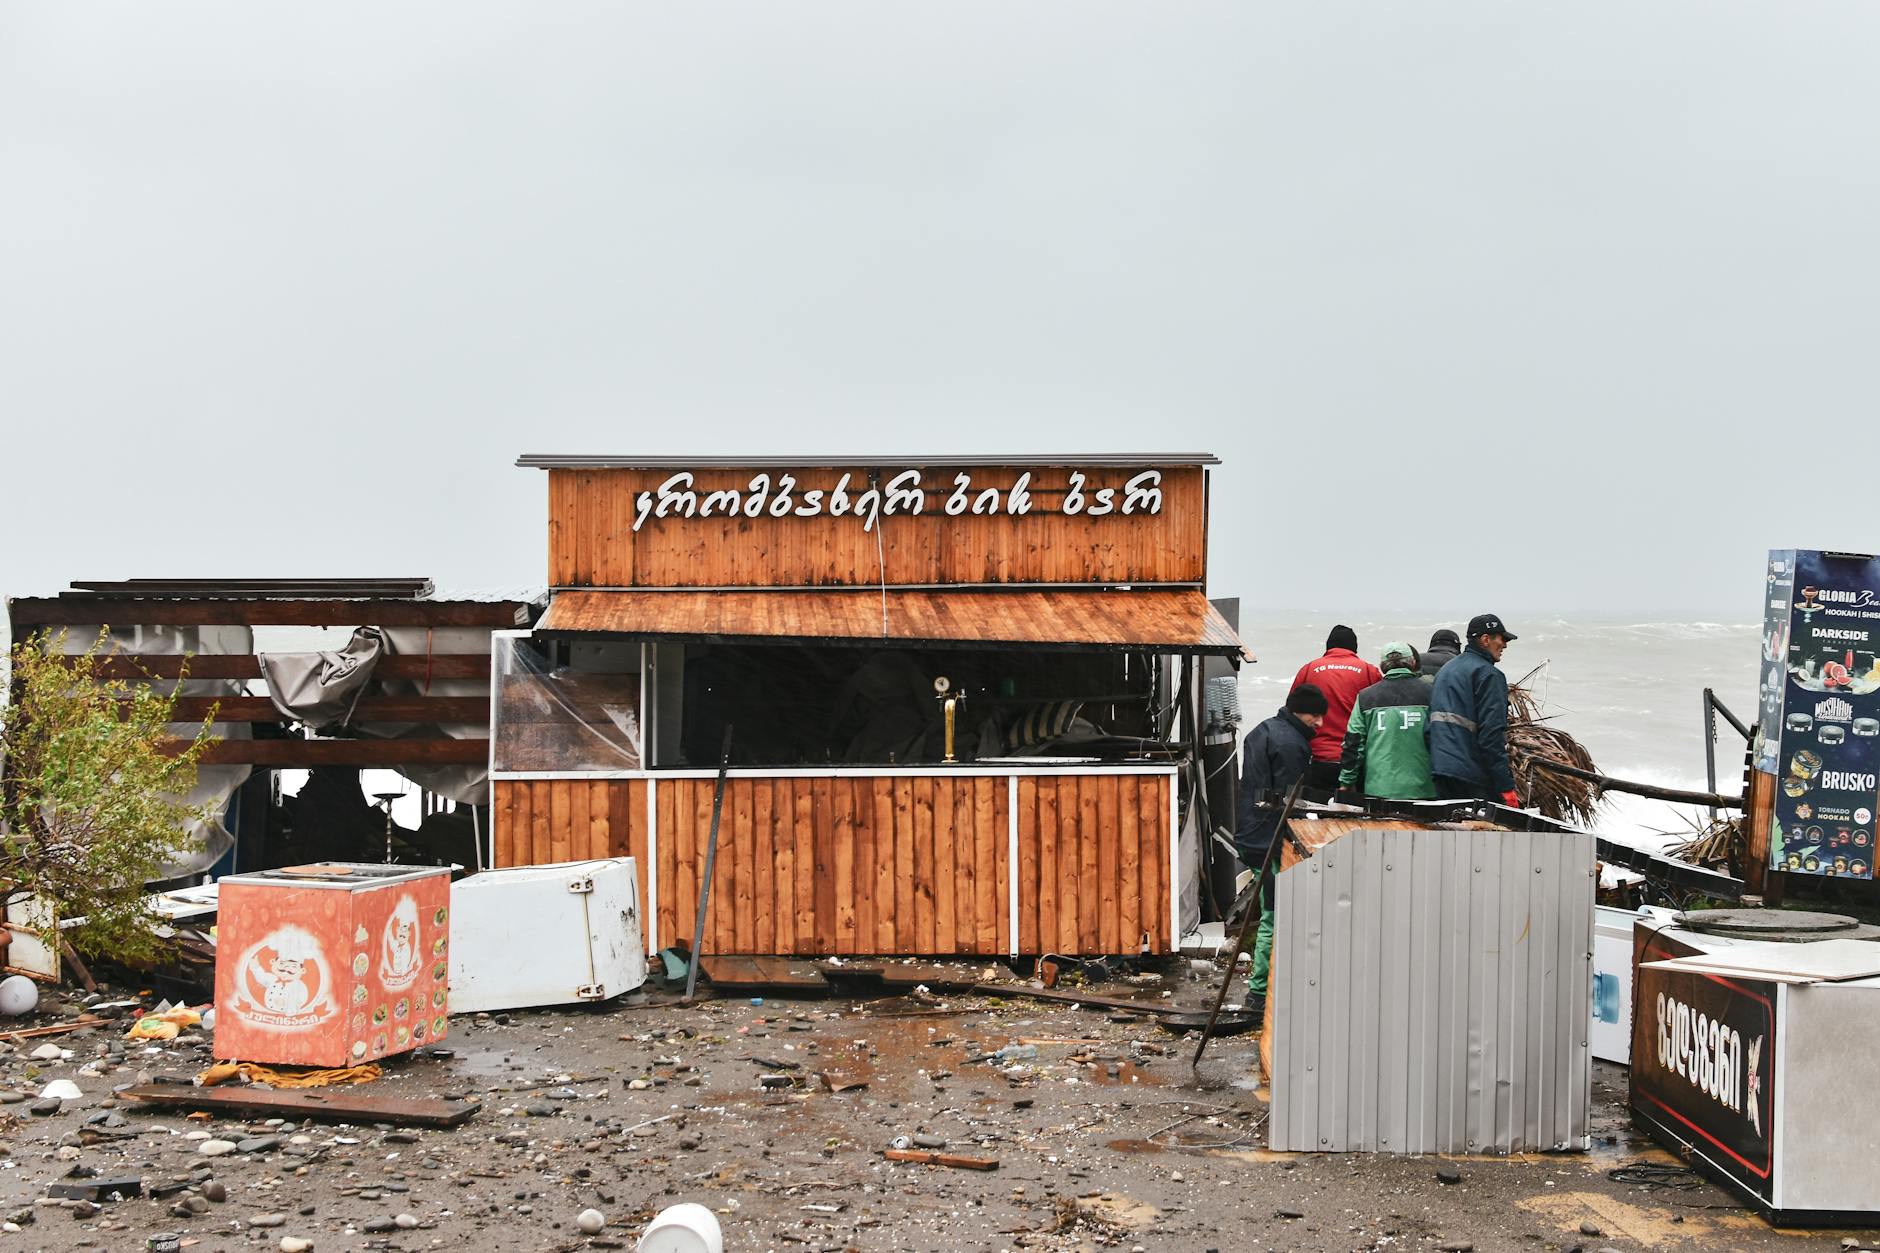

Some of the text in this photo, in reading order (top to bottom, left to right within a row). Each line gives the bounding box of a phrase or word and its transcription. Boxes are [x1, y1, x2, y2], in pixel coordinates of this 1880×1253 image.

[1062, 470, 1162, 517] ბარ
[1819, 590, 1880, 608] GLORIA Bea
[1825, 609, 1858, 617] HOOKAH
[1812, 628, 1869, 641] DARKSIDE
[1822, 771, 1876, 791] BRUSKO
[1818, 807, 1850, 815] TORNADO
